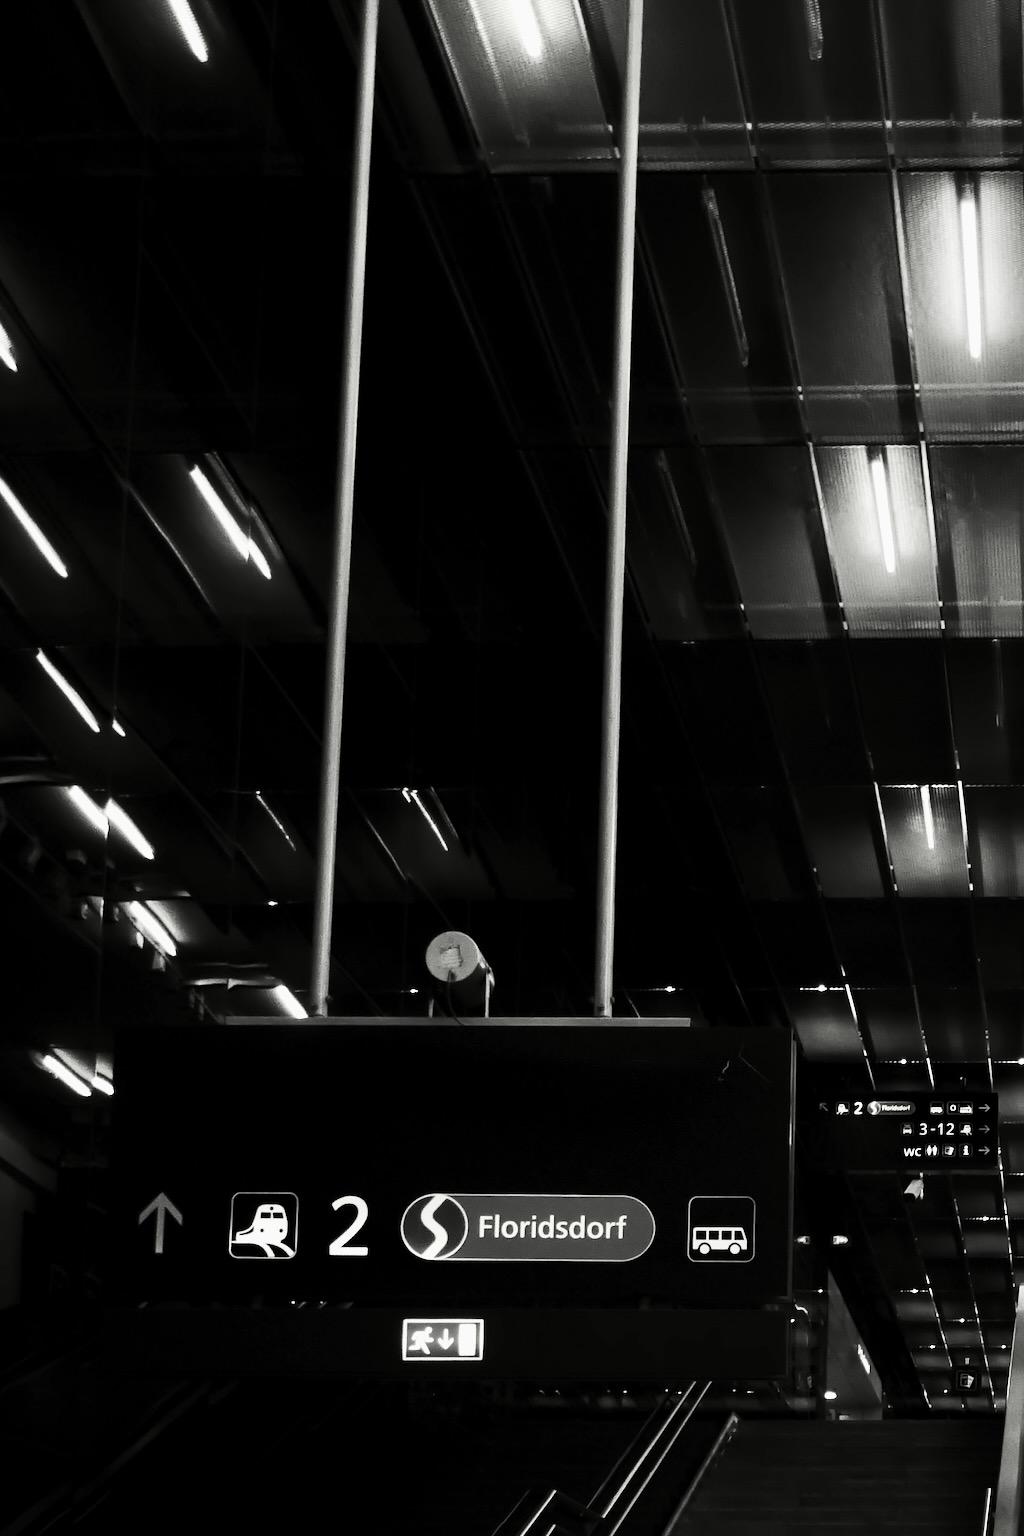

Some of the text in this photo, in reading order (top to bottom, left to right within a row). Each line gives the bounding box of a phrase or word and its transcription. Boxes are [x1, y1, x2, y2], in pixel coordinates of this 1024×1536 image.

[853, 1102, 863, 1115] 2
[327, 1193, 370, 1257] 2
[479, 1214, 628, 1241] Floridsdorf
